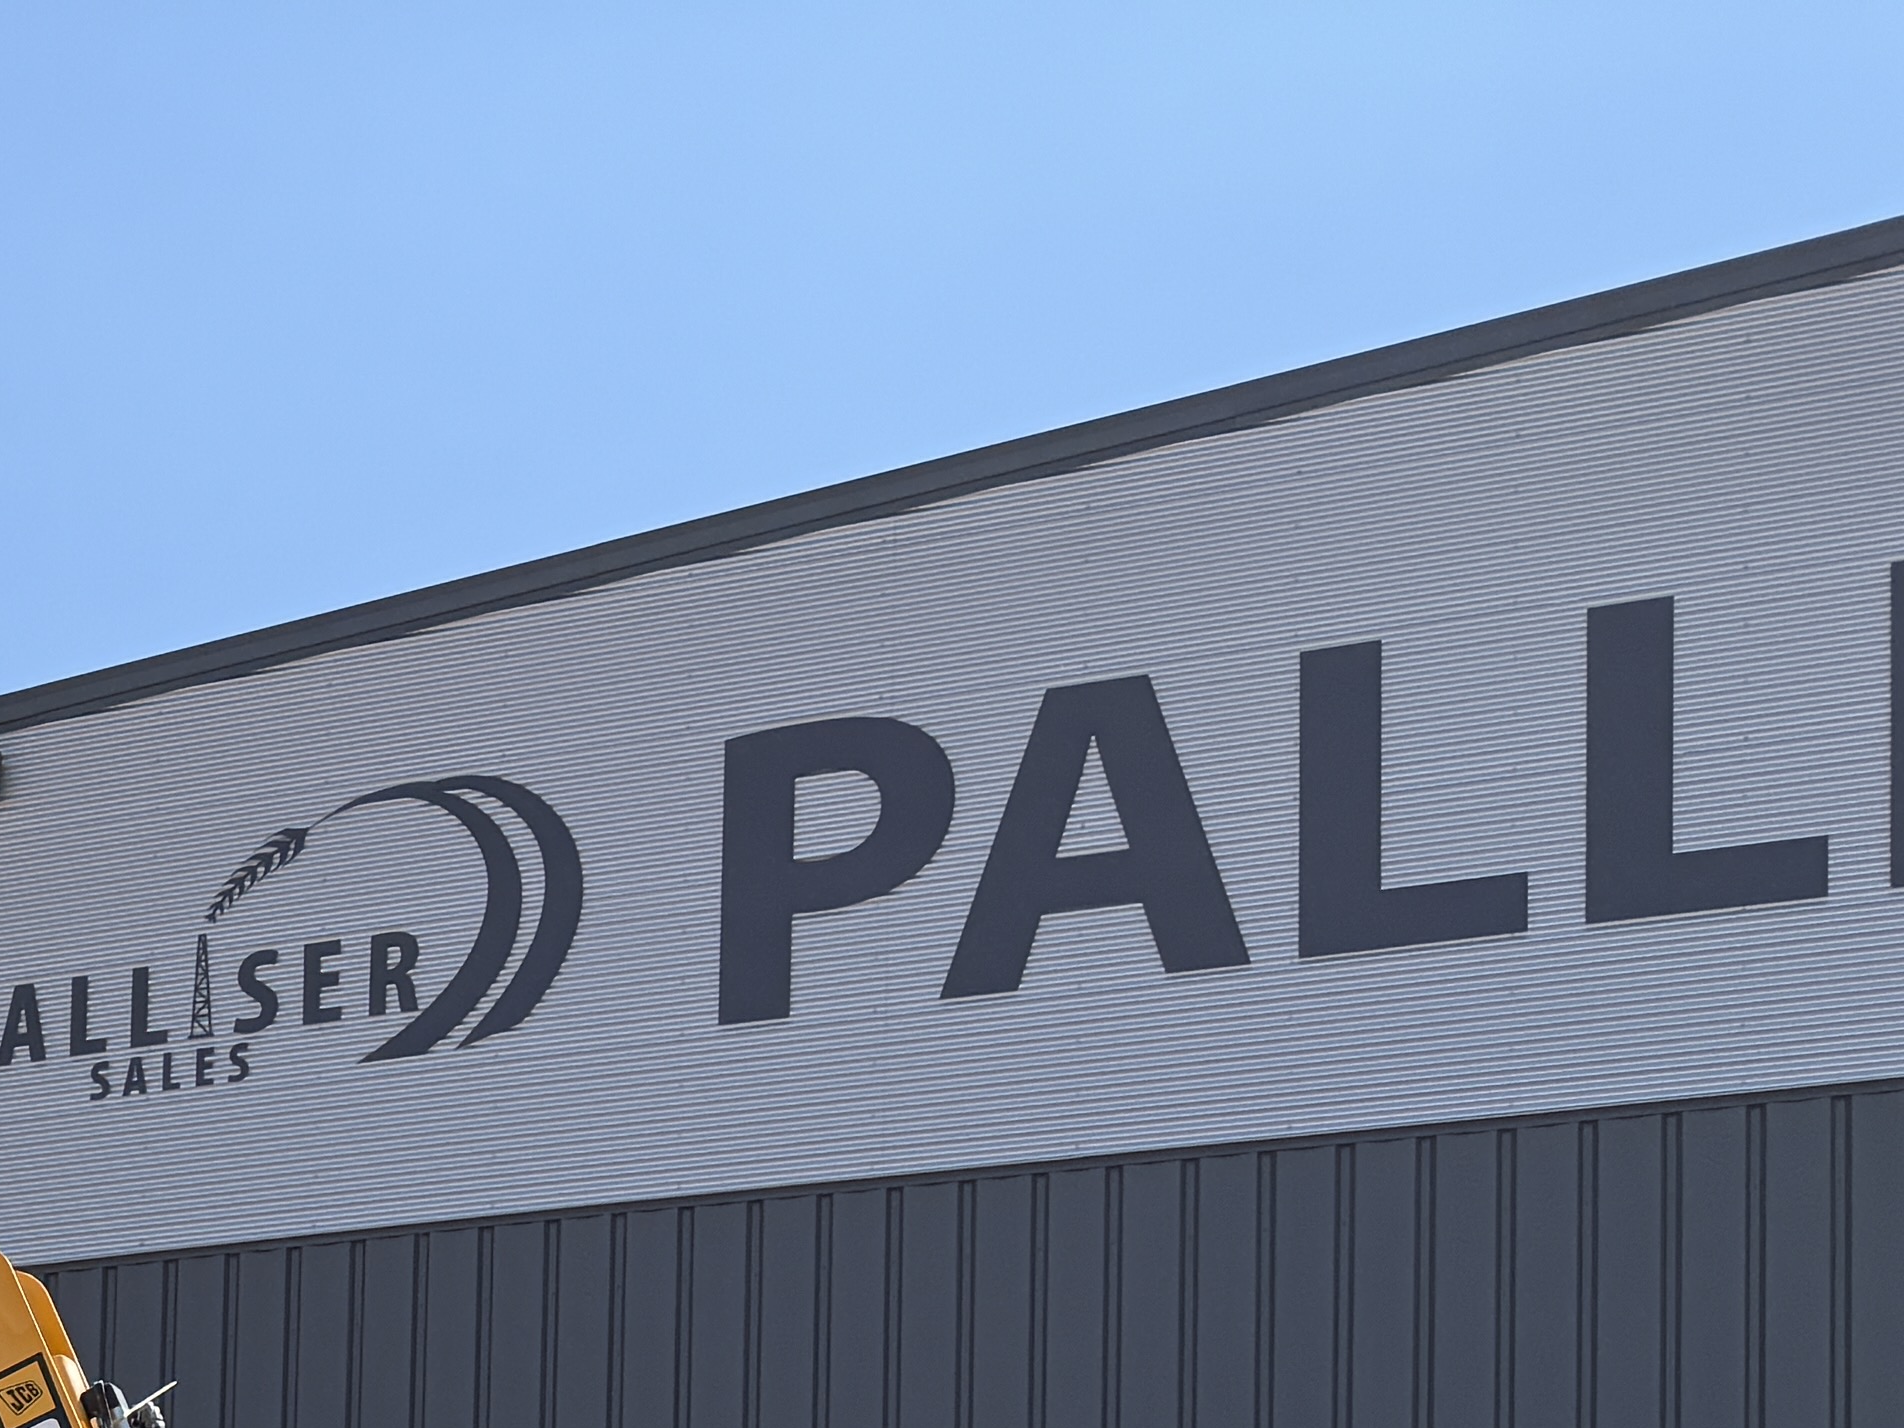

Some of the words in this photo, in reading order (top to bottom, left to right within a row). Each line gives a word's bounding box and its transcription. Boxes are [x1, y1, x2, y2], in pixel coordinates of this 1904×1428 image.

[717, 558, 1904, 1025] PALL
[90, 1042, 250, 1100] SALES
[4, 1381, 42, 1413] JCB
